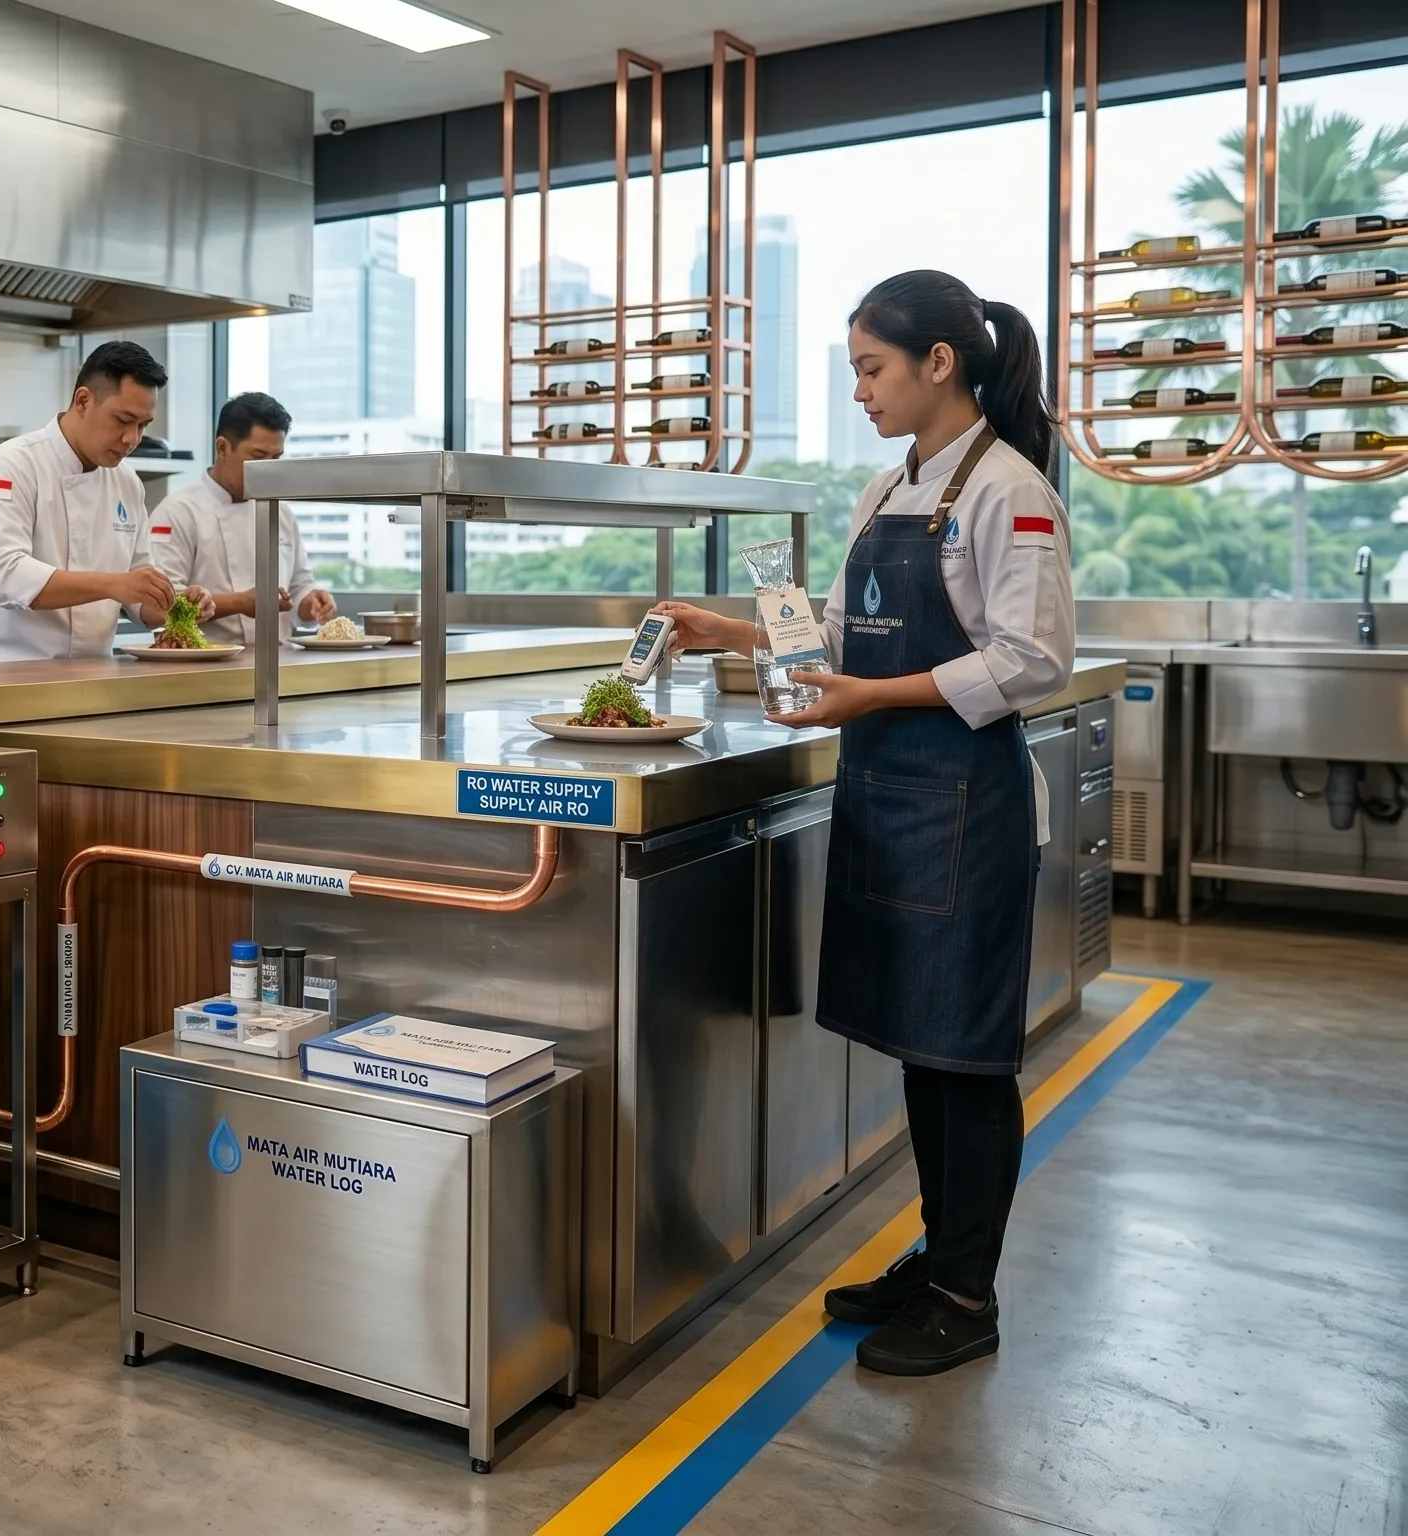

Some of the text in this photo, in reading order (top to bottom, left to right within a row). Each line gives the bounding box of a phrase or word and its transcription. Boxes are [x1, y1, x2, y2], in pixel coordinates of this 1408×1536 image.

[467, 776, 602, 799] RO WATER SUPPLY
[479, 795, 589, 817] SUPPLY AIR RO
[226, 864, 344, 889] CV. MATA AIR MUTIARA
[353, 1061, 429, 1088] WATER LOG
[247, 1135, 397, 1182] MATA AIR MUTIARA
[272, 1161, 363, 1195] WATER LOG
